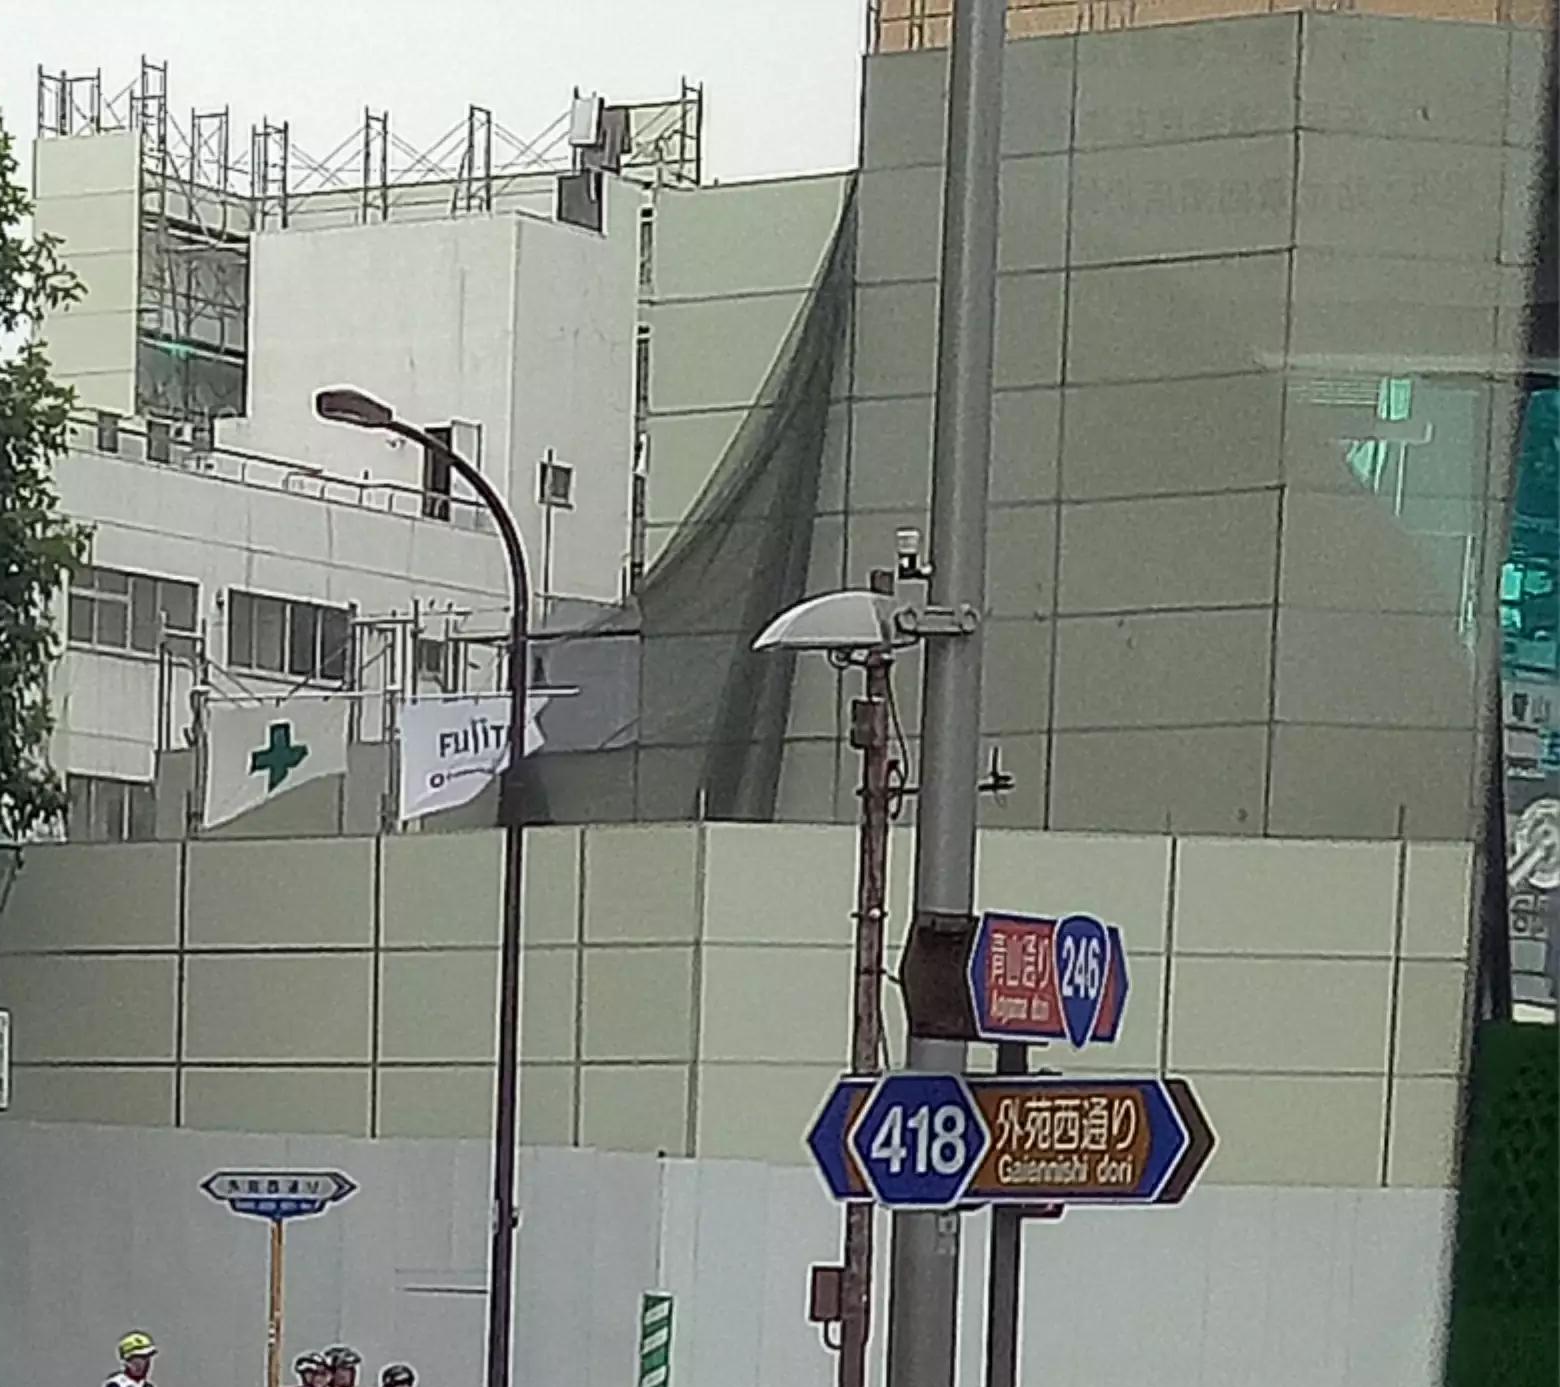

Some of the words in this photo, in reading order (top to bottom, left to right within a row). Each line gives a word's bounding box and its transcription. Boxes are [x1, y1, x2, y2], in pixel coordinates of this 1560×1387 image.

[1061, 935, 1101, 1000] 246
[870, 1105, 966, 1175] 418
[996, 1096, 1137, 1151] 外苑西通り
[1096, 1154, 1133, 1184] dori
